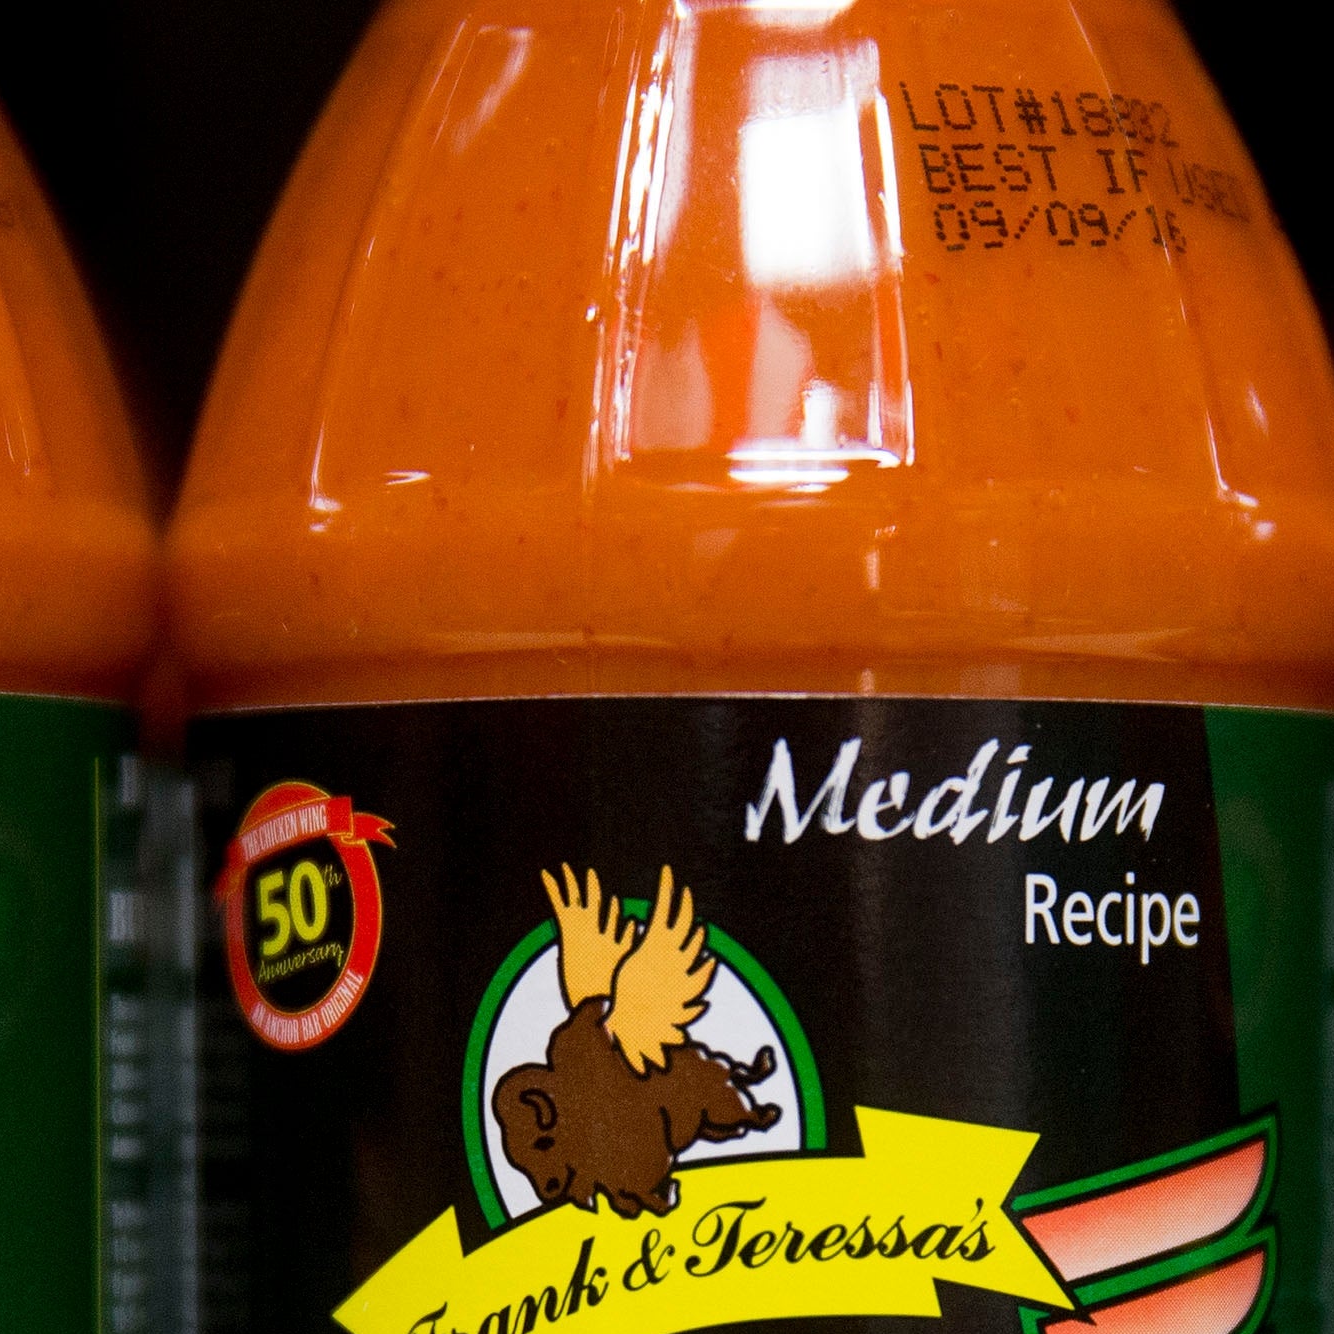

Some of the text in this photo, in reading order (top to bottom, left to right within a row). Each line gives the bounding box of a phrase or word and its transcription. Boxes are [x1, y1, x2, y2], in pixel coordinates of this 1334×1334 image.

[918, 143, 1056, 193] BEST
[1096, 148, 1148, 194] IF
[299, 802, 327, 836] WING
[744, 737, 1165, 845] Medium
[1024, 871, 1200, 965] Recipe
[258, 941, 344, 982] Anniversary
[320, 968, 364, 1026] ORIGINAL
[621, 1229, 674, 1291] &
[685, 1196, 997, 1277] Teressa's
